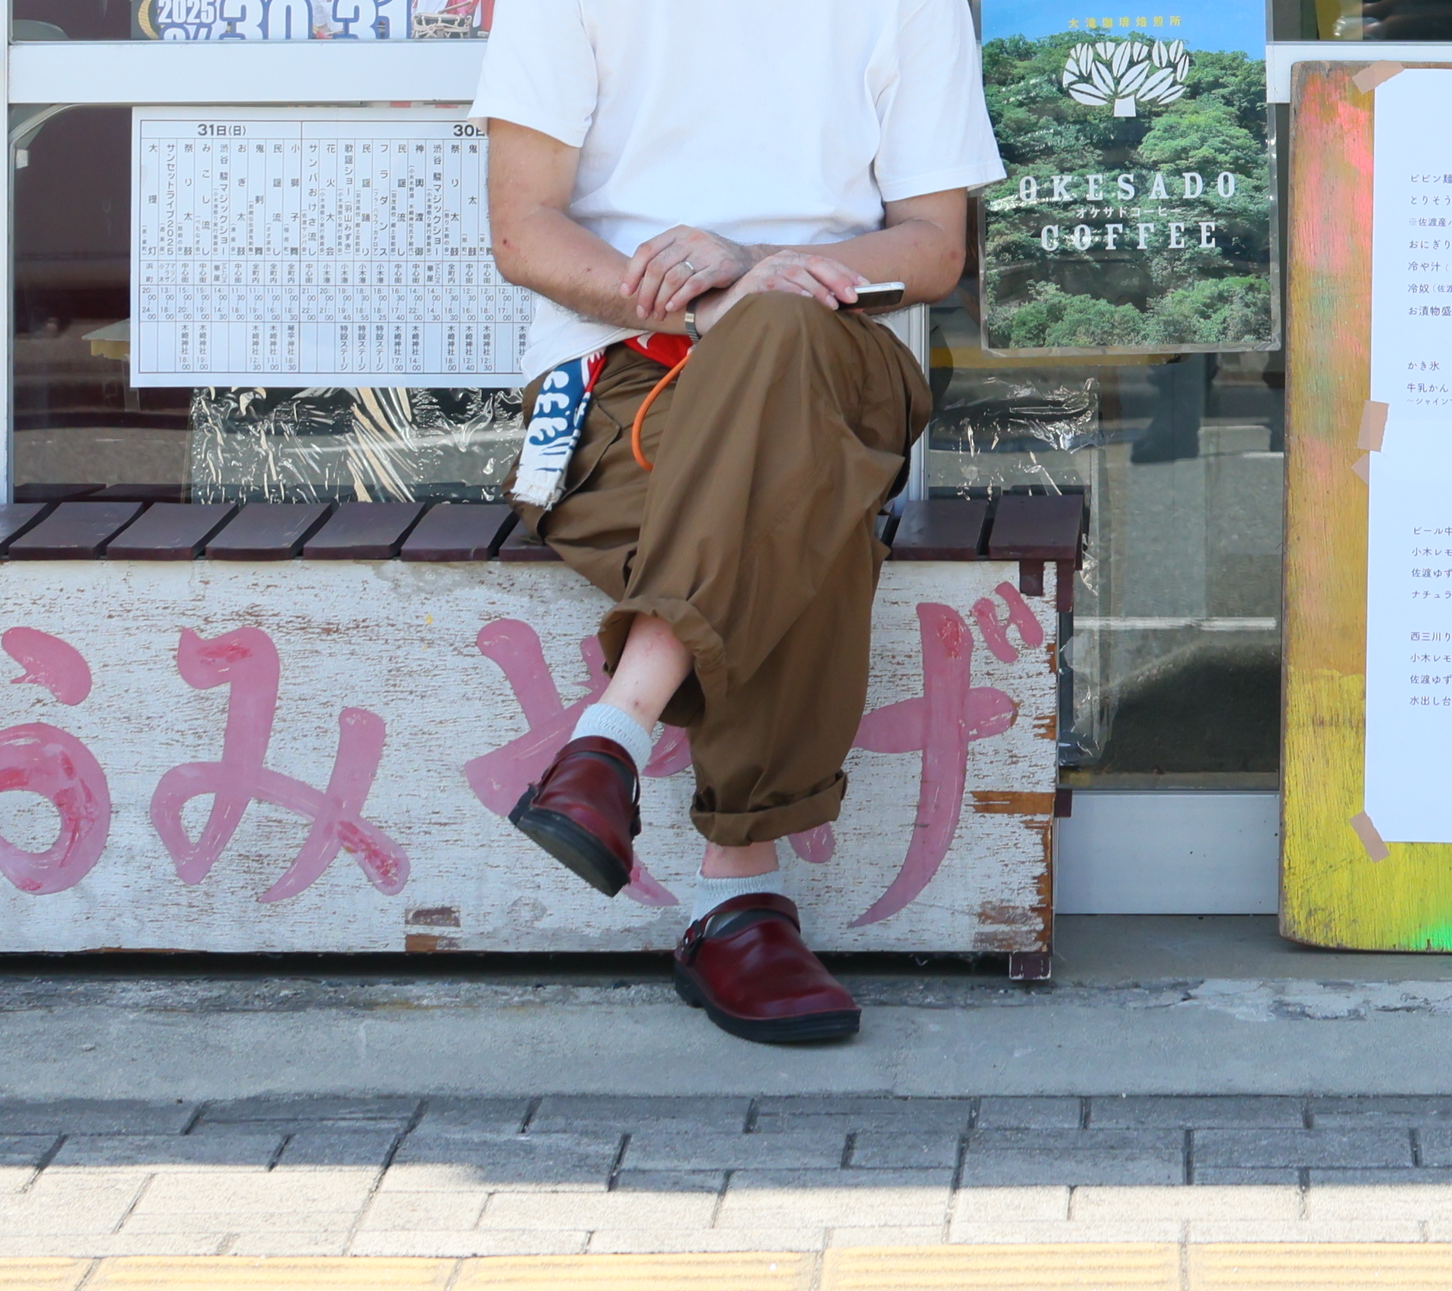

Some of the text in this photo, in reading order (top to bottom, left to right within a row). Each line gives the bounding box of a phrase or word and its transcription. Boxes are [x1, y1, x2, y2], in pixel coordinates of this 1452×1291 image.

[1019, 172, 1236, 202] OKESADO
[379, 144, 389, 256] フラダンス
[1076, 206, 1182, 218] オケサドコーヒー
[1041, 221, 1217, 251] COFFEE
[1408, 361, 1439, 371] かき氷
[1407, 383, 1448, 393] 牛乳かん
